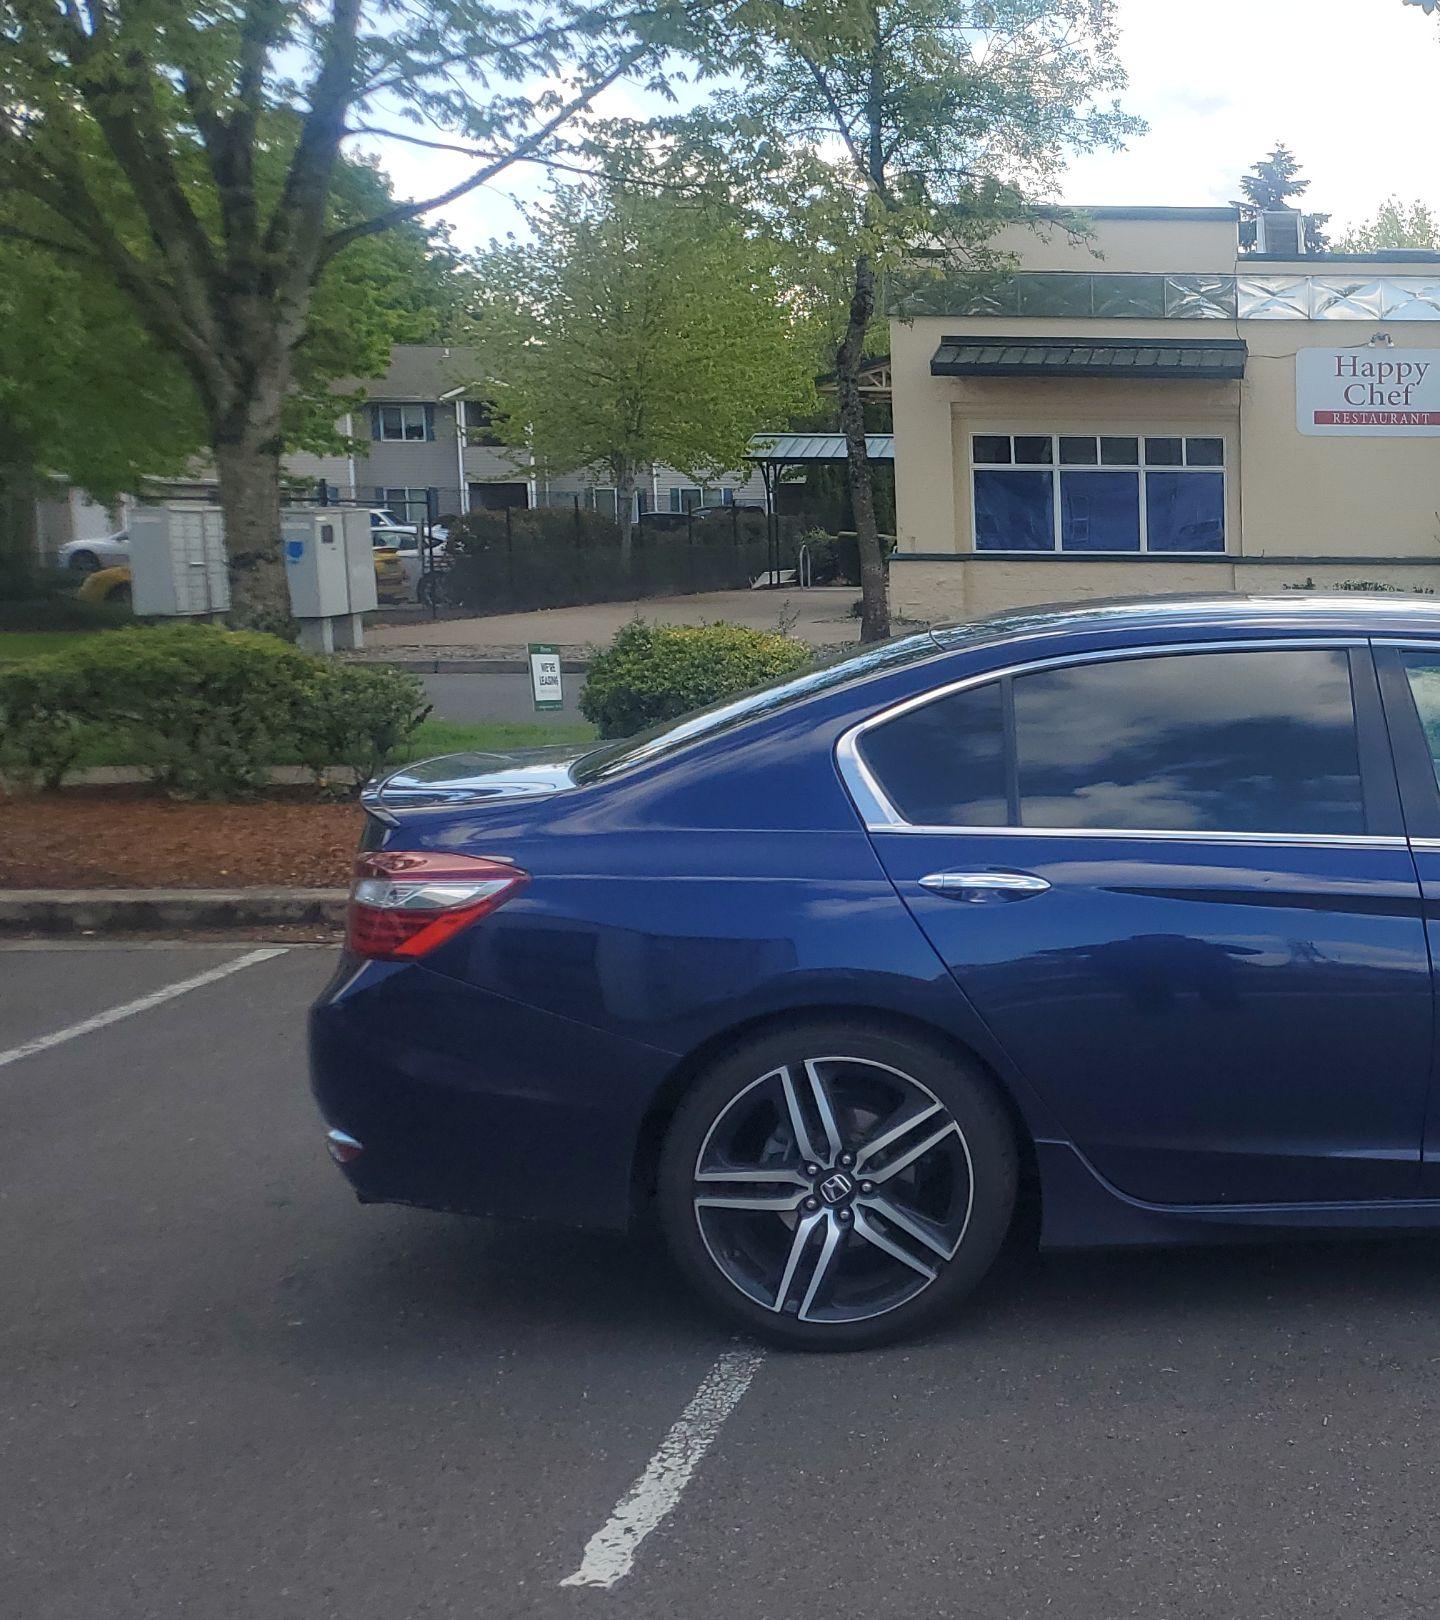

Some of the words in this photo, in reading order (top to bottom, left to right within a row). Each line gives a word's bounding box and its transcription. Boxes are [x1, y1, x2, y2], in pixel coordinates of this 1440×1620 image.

[1334, 356, 1430, 385] Happy
[1344, 383, 1415, 406] Chef
[1333, 412, 1431, 425] RESTAURANT
